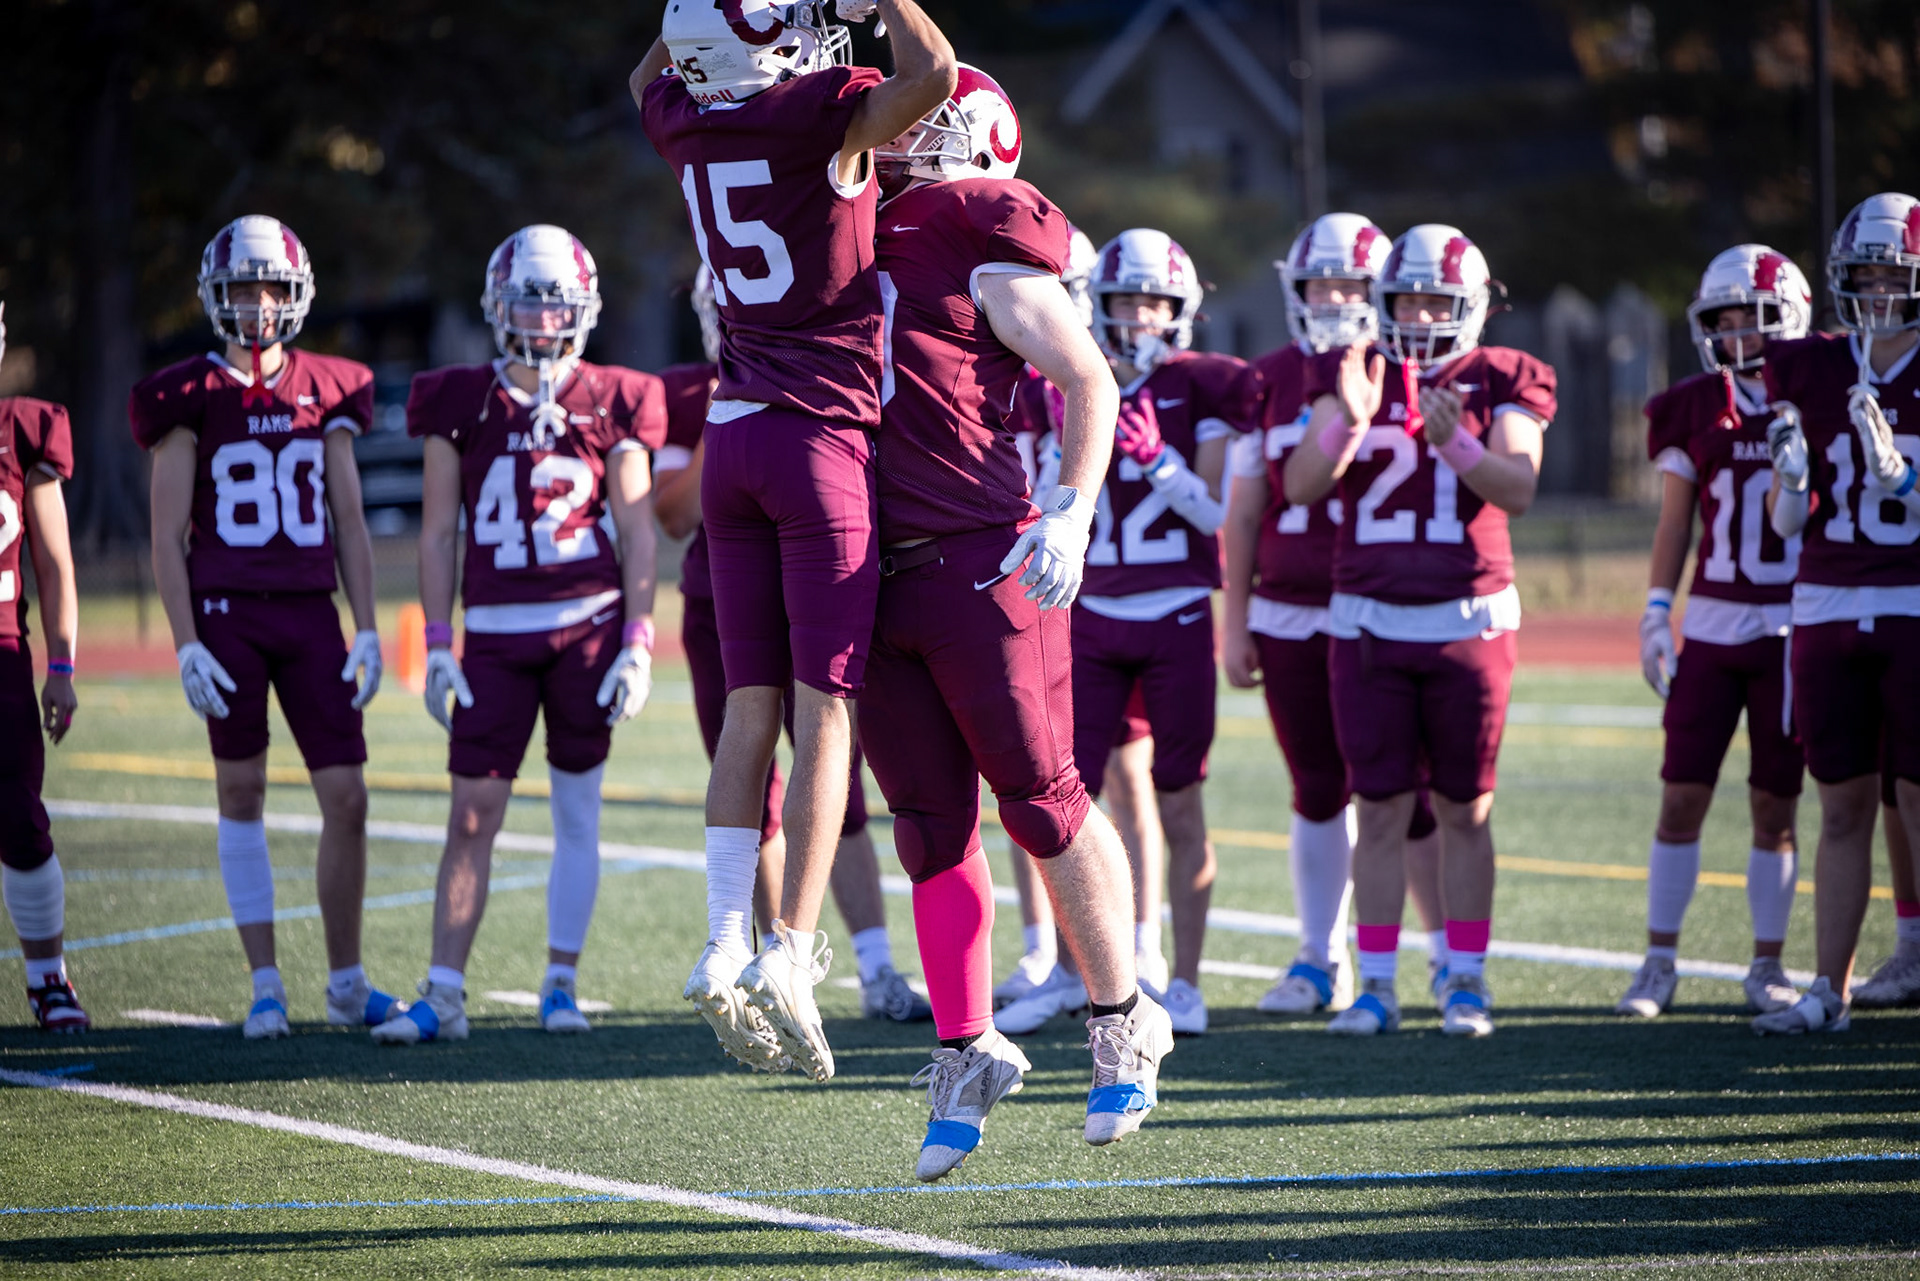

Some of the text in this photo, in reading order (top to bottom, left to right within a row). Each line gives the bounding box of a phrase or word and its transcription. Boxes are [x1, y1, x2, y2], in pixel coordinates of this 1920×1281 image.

[676, 56, 708, 85] 15
[695, 89, 735, 105] ddell
[919, 135, 946, 162] XNITH
[681, 159, 795, 307] 15
[247, 414, 293, 434] RAMS
[1732, 440, 1774, 461] RAM
[211, 438, 326, 547] 80
[474, 455, 600, 570] 42
[1355, 425, 1465, 545] 21
[1704, 468, 1804, 586] 10
